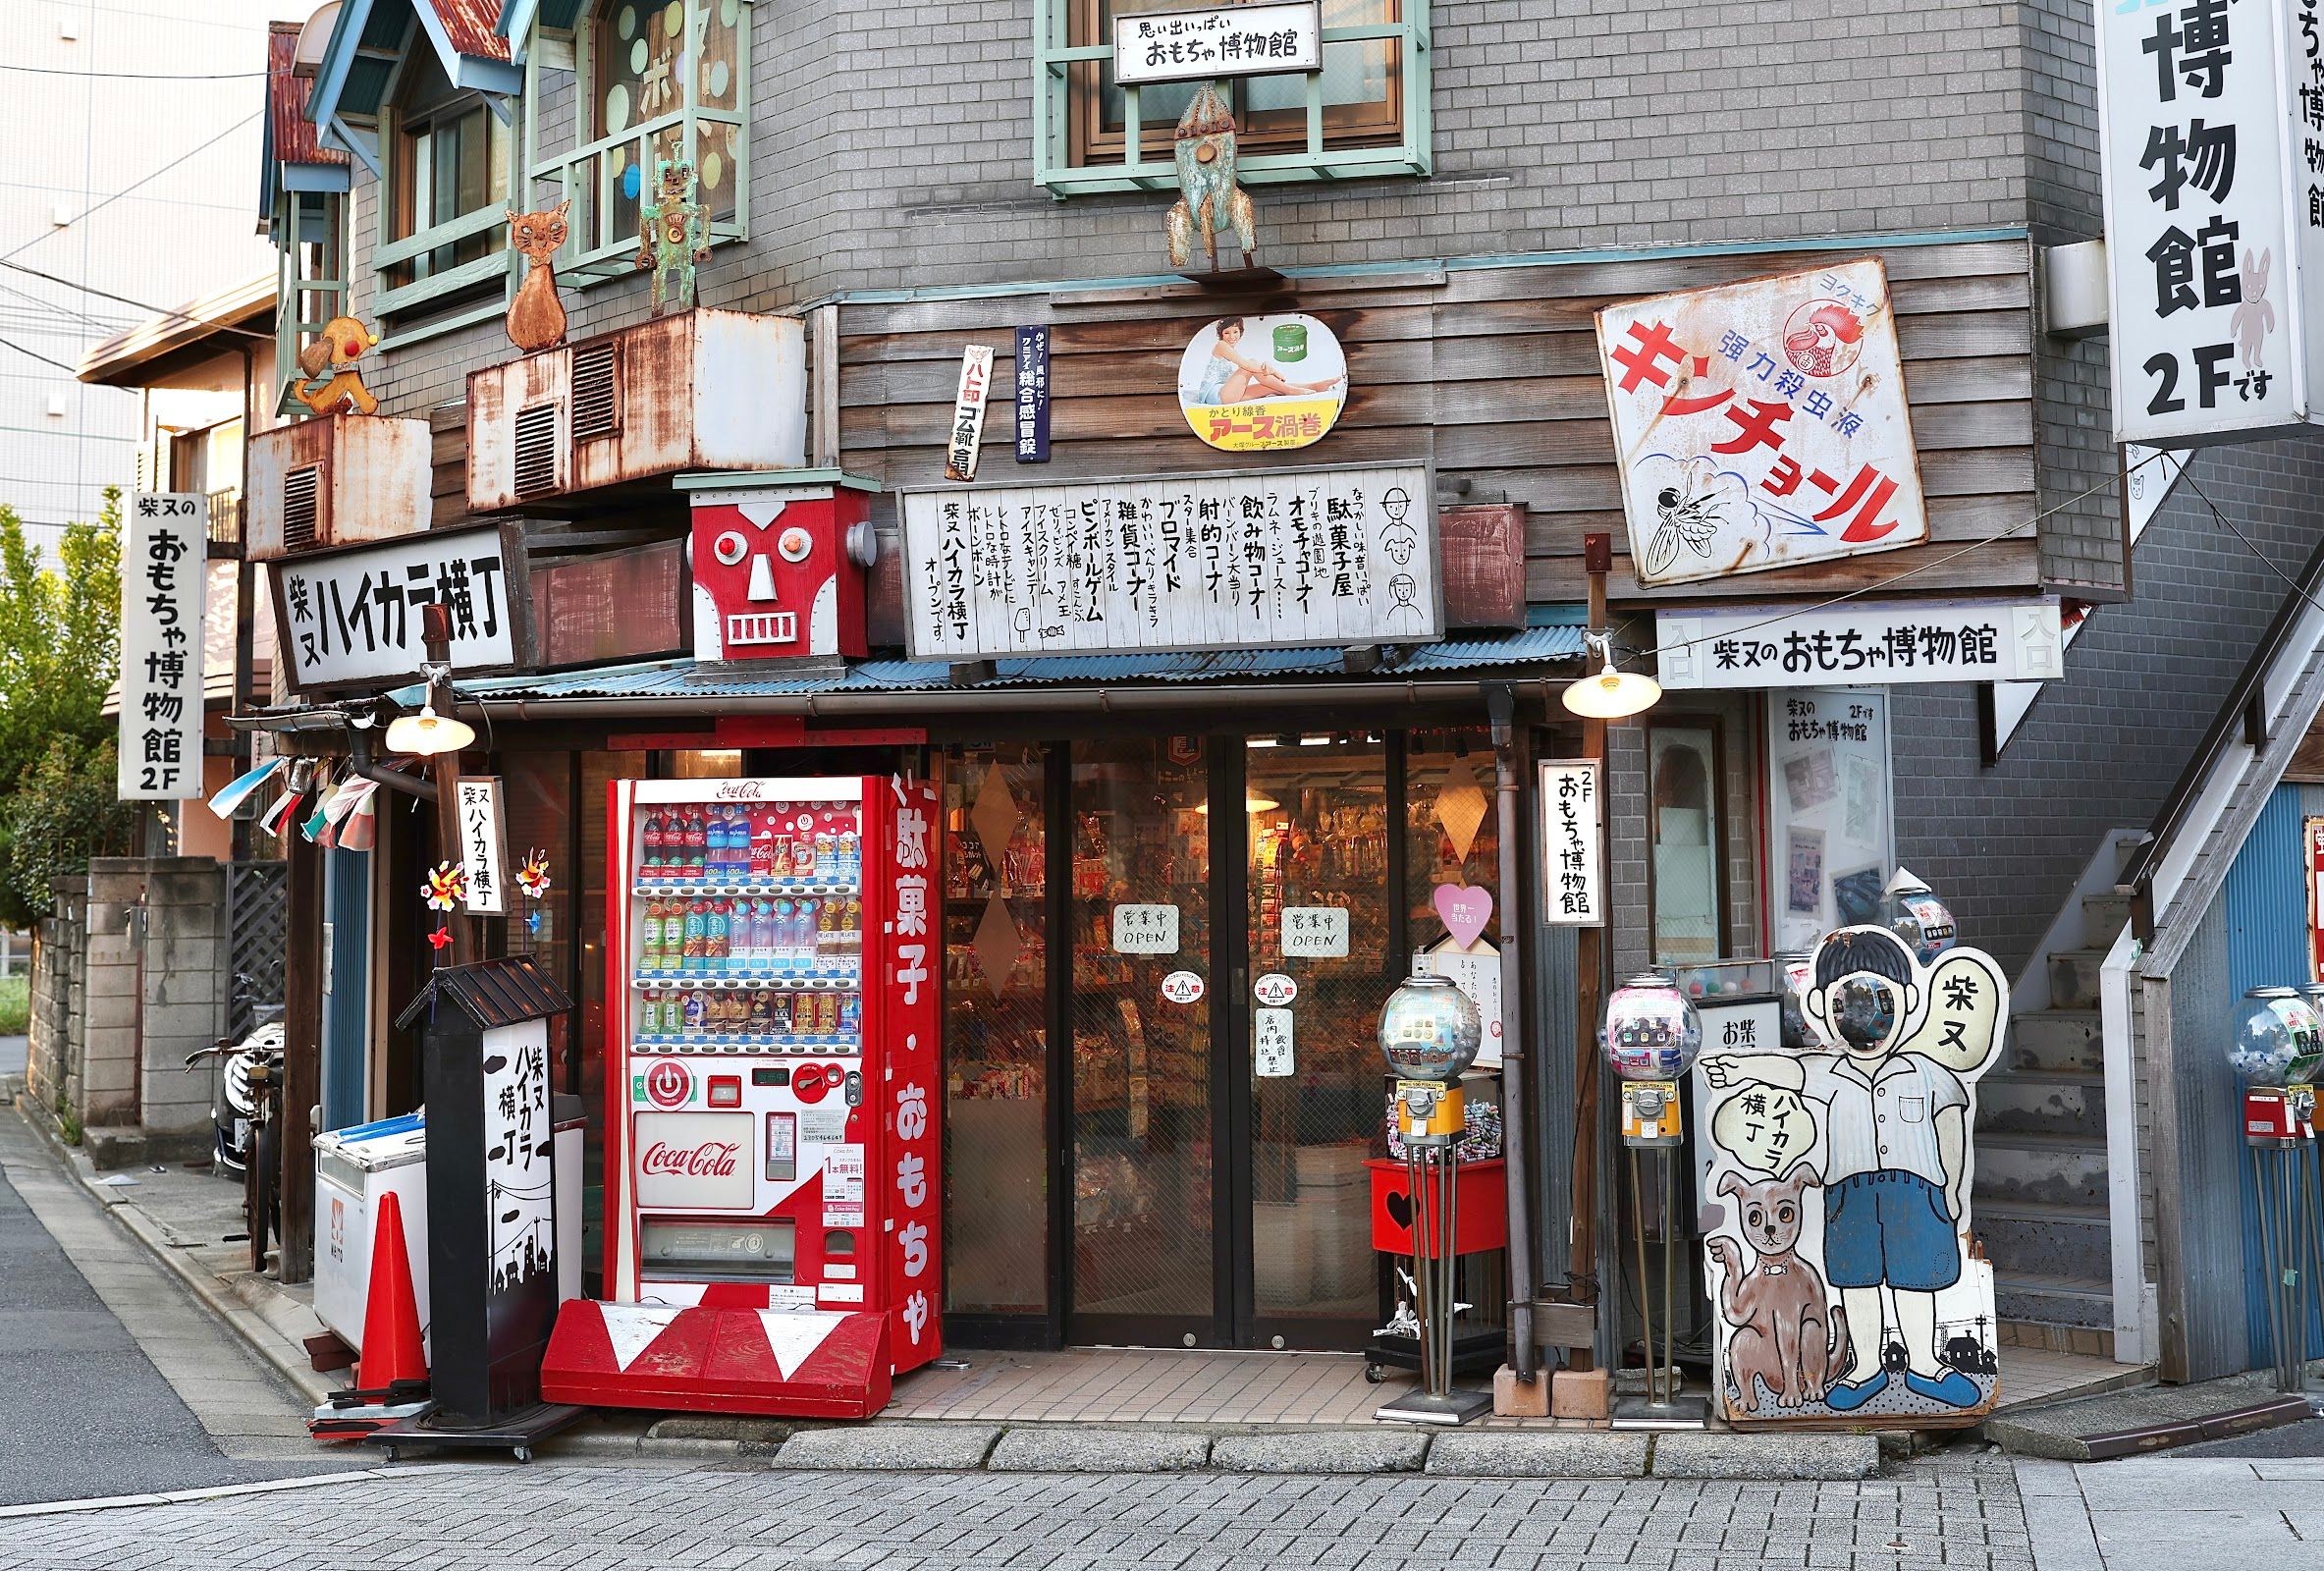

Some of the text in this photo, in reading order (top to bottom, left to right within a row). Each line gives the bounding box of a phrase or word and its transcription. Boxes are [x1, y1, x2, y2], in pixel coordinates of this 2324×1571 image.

[1138, 15, 1231, 39] 思い出いっぱい
[1145, 28, 1298, 67] おもちゃ博物館
[1820, 274, 1881, 316] ヨクキク
[1209, 405, 1267, 418] かとり線香
[1210, 412, 1322, 442] アース渦巻
[1609, 320, 1900, 543] キンチョール
[137, 498, 196, 517] 柴又の
[1183, 494, 1197, 558] スター集合
[1308, 486, 1329, 578] ブリキの遊園地
[943, 503, 968, 640] 柴又ハイカラ横丁
[984, 508, 1002, 601] レトロな時計が
[998, 506, 1016, 604] レトロなテレビに
[1020, 507, 1038, 607] アイスキャンデー
[1035, 505, 1054, 595] アイスクリーム
[1081, 498, 1104, 622] ピンボールゲーム
[1117, 500, 1147, 612] 雑貨コーナー
[1159, 500, 1181, 593] ブロマイド
[1199, 498, 1223, 603] 射的コーナー
[1240, 495, 1266, 621] 飲み物コーナー
[1288, 496, 1314, 615] オモチャコーナー
[1326, 498, 1354, 597] 駄菓子屋
[1057, 580, 1072, 617] アメ玉
[141, 528, 188, 764] おもちゃ博物館
[1712, 623, 1998, 674] 柴又のおもちゃ博物館
[1787, 720, 1867, 742] おもちゃ博物館
[139, 767, 180, 790] 2F
[463, 786, 490, 805] 柴又
[469, 809, 492, 905] ハイカラ横丁
[1559, 774, 1590, 914] おもちゃ博物館
[1123, 910, 1167, 927] 営業中
[1124, 930, 1166, 944] OPEN
[1292, 914, 1333, 930] 営業中
[1293, 934, 1337, 947] OPEN
[1453, 903, 1475, 913] 世界一
[1938, 975, 1978, 1053] 柴又
[515, 1045, 532, 1171] ハイカラ
[531, 1047, 544, 1111] 柴又
[498, 1085, 516, 1165] 横丁
[1741, 1094, 1767, 1142] 横丁
[1765, 1096, 1798, 1169] ハイカラ
[642, 1142, 742, 1176] Coca-Cola
